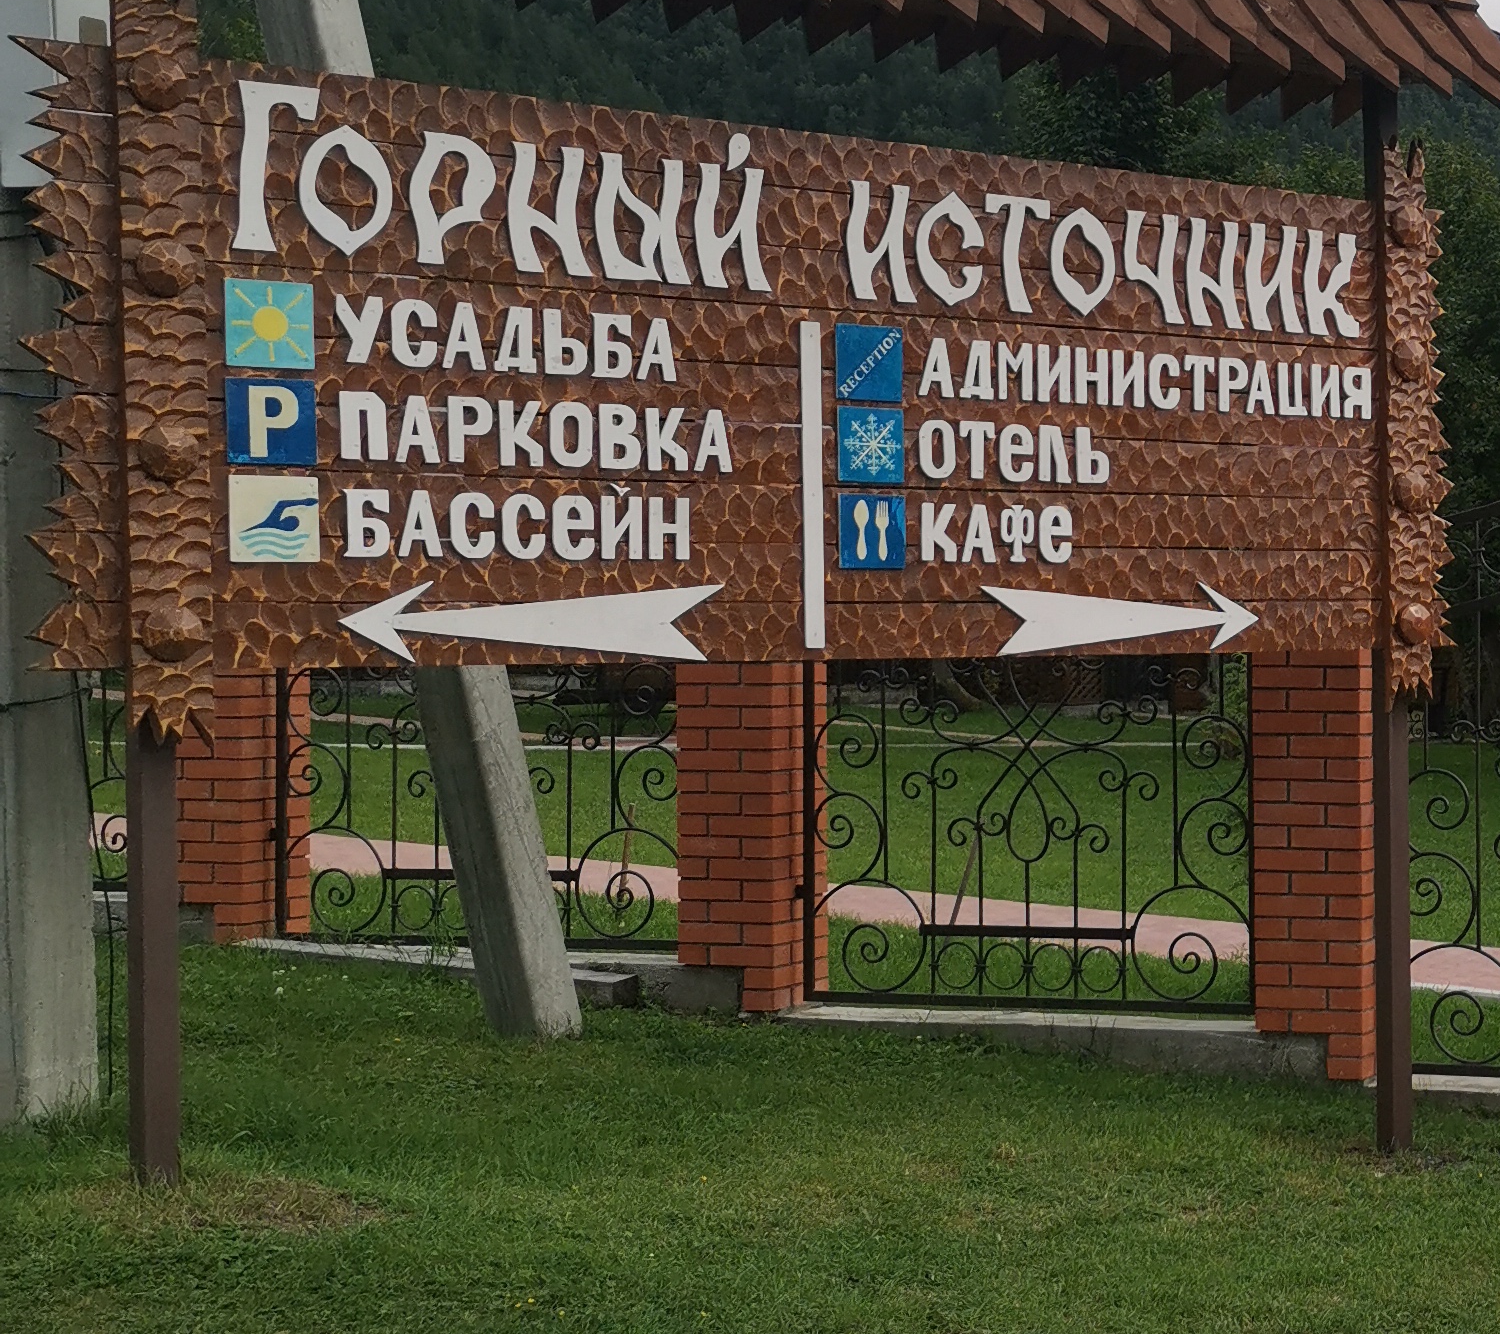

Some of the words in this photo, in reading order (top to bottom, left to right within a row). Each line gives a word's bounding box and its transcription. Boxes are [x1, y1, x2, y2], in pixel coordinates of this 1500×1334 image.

[845, 179, 1360, 338] ИСТОЧНИК
[335, 294, 677, 382] УСАДЬБА
[838, 327, 902, 399] RECEPTION
[918, 336, 1373, 420] АДМИНИСТРАЦИЯ
[338, 390, 734, 473] ПАРКОВКА
